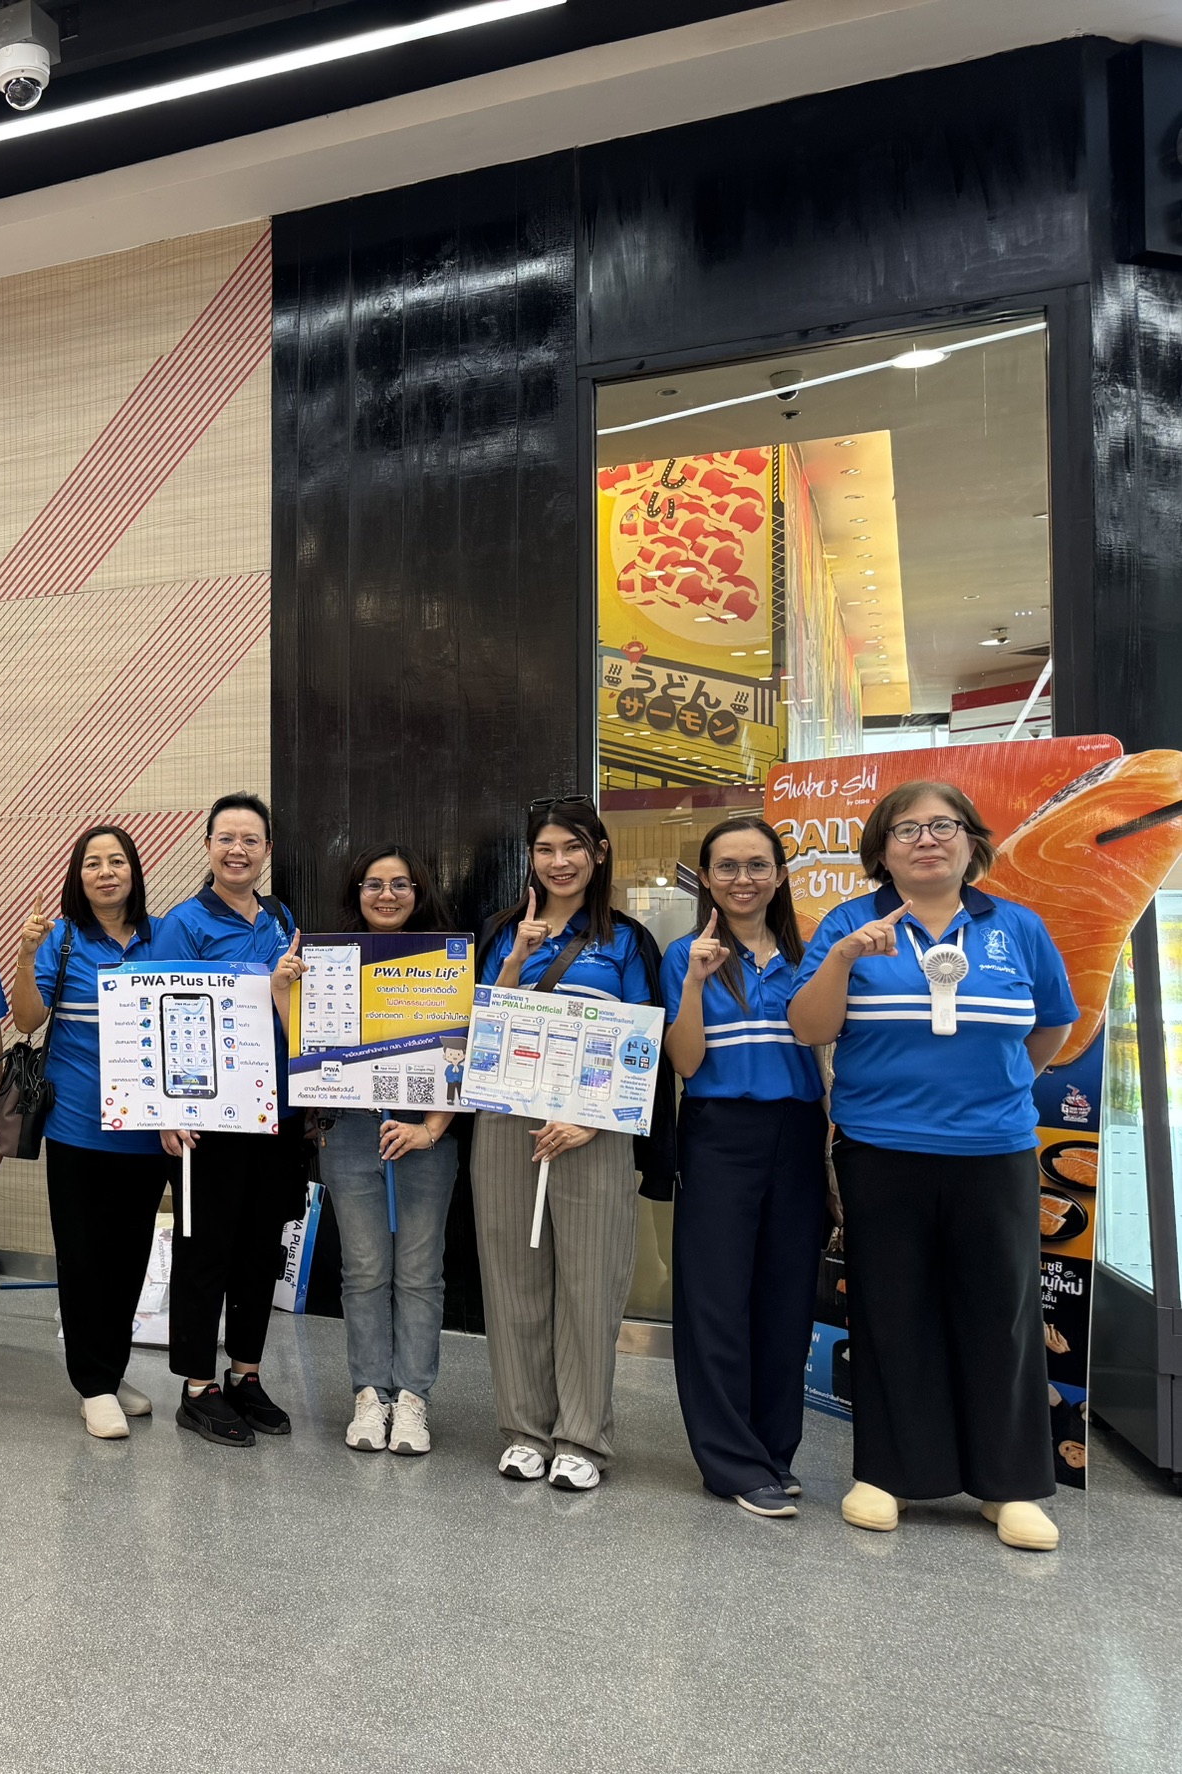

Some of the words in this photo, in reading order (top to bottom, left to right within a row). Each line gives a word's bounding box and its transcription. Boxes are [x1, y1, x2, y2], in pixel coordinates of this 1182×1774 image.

[631, 665, 722, 709] うどん
[620, 696, 736, 737] サーモン
[374, 967, 402, 978] PWA
[405, 967, 432, 978] Plus
[131, 974, 166, 987] PWA
[170, 974, 204, 987] Plus
[376, 984, 409, 993] จ่ายค่าน้ำ
[412, 984, 458, 994] จ่ายค่าติดตั้ง
[502, 1000, 519, 1009] PWA
[520, 1002, 535, 1012] Line
[536, 1004, 563, 1015] Official
[287, 1233, 301, 1260] Plus
